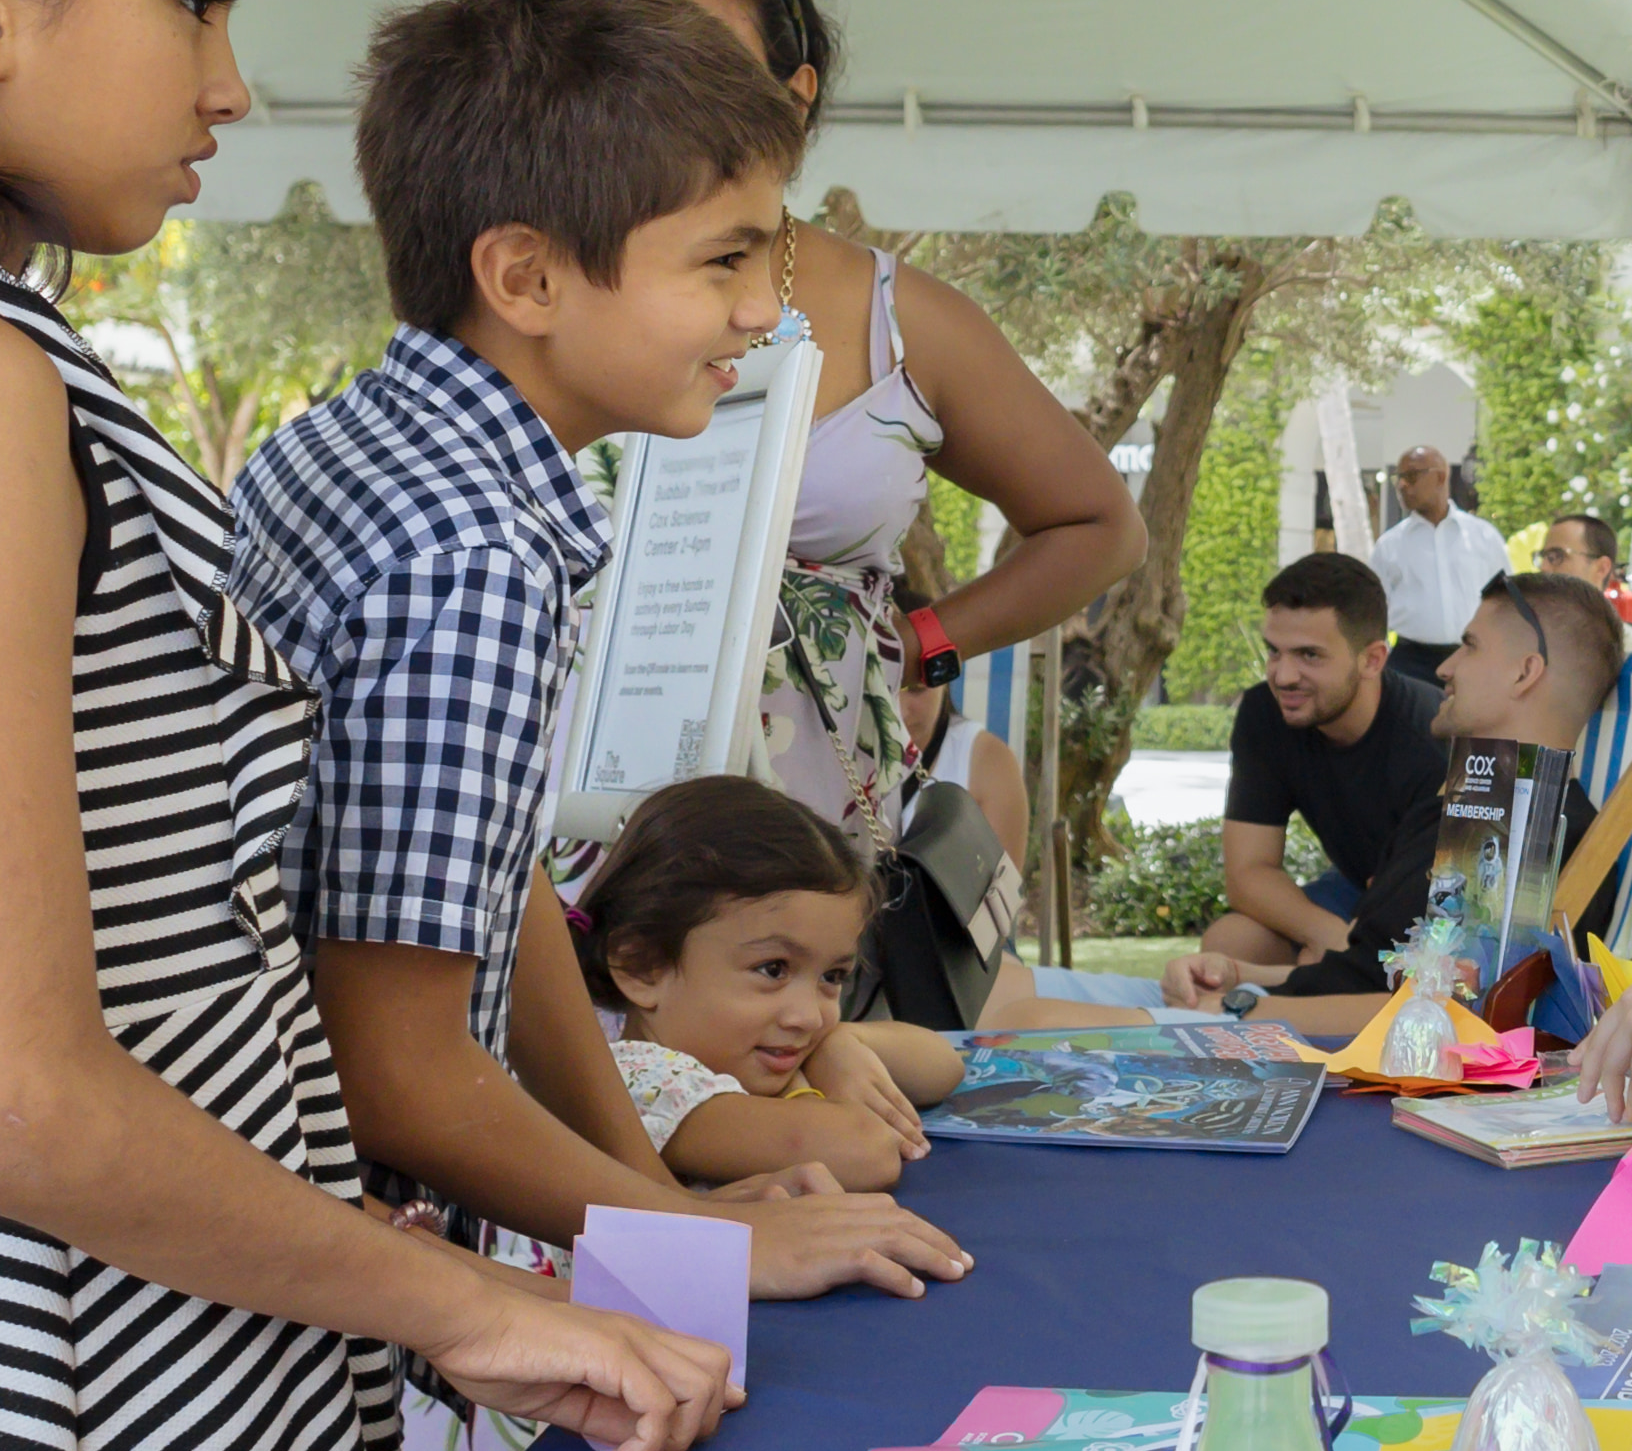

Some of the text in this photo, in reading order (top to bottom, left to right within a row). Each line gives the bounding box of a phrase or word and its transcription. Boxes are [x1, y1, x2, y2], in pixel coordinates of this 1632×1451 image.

[649, 509, 711, 530] Cox Science
[644, 538, 679, 558] Center
[1464, 753, 1497, 777] COX
[1446, 802, 1506, 823] MEMBERSHIP
